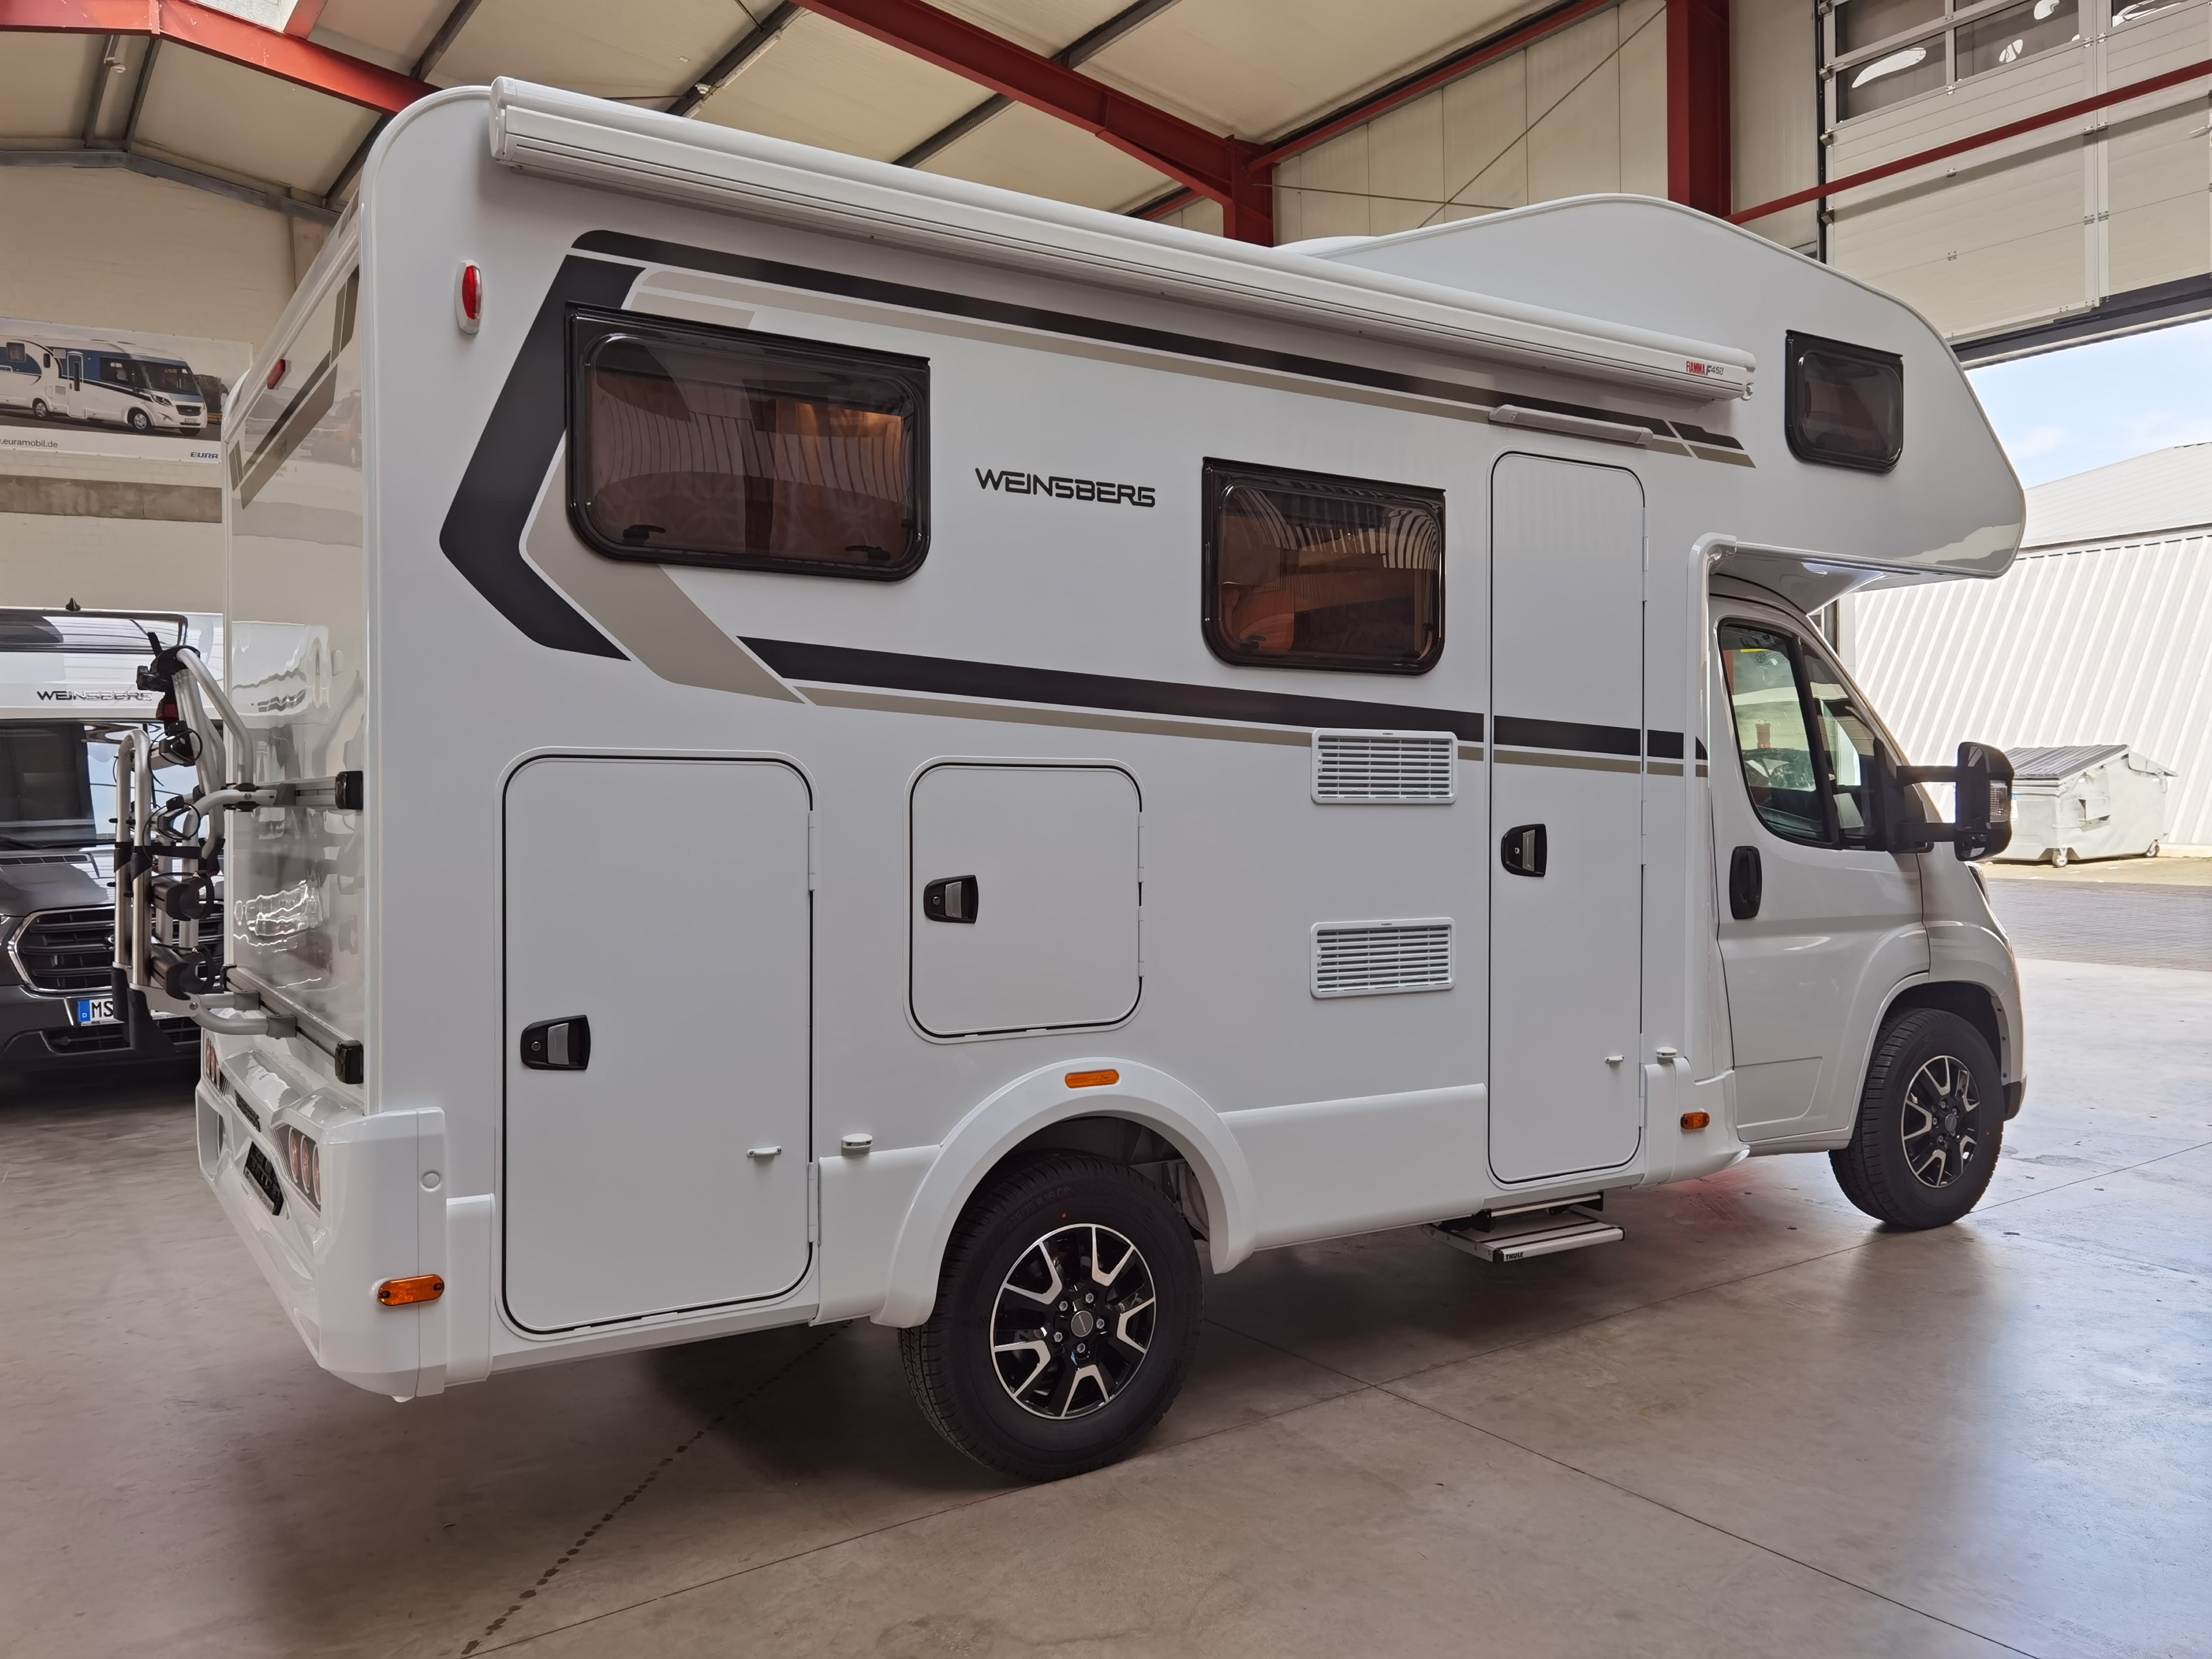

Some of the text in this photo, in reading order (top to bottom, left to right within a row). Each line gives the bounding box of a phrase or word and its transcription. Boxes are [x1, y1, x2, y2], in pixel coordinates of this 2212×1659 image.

[1686, 361, 1705, 375] FIAMMA
[0, 439, 58, 448] .euramobil.de
[975, 468, 1156, 508] WEINSBERG
[37, 691, 153, 701] WEINSBERG
[1506, 1251, 1523, 1260] THULE
